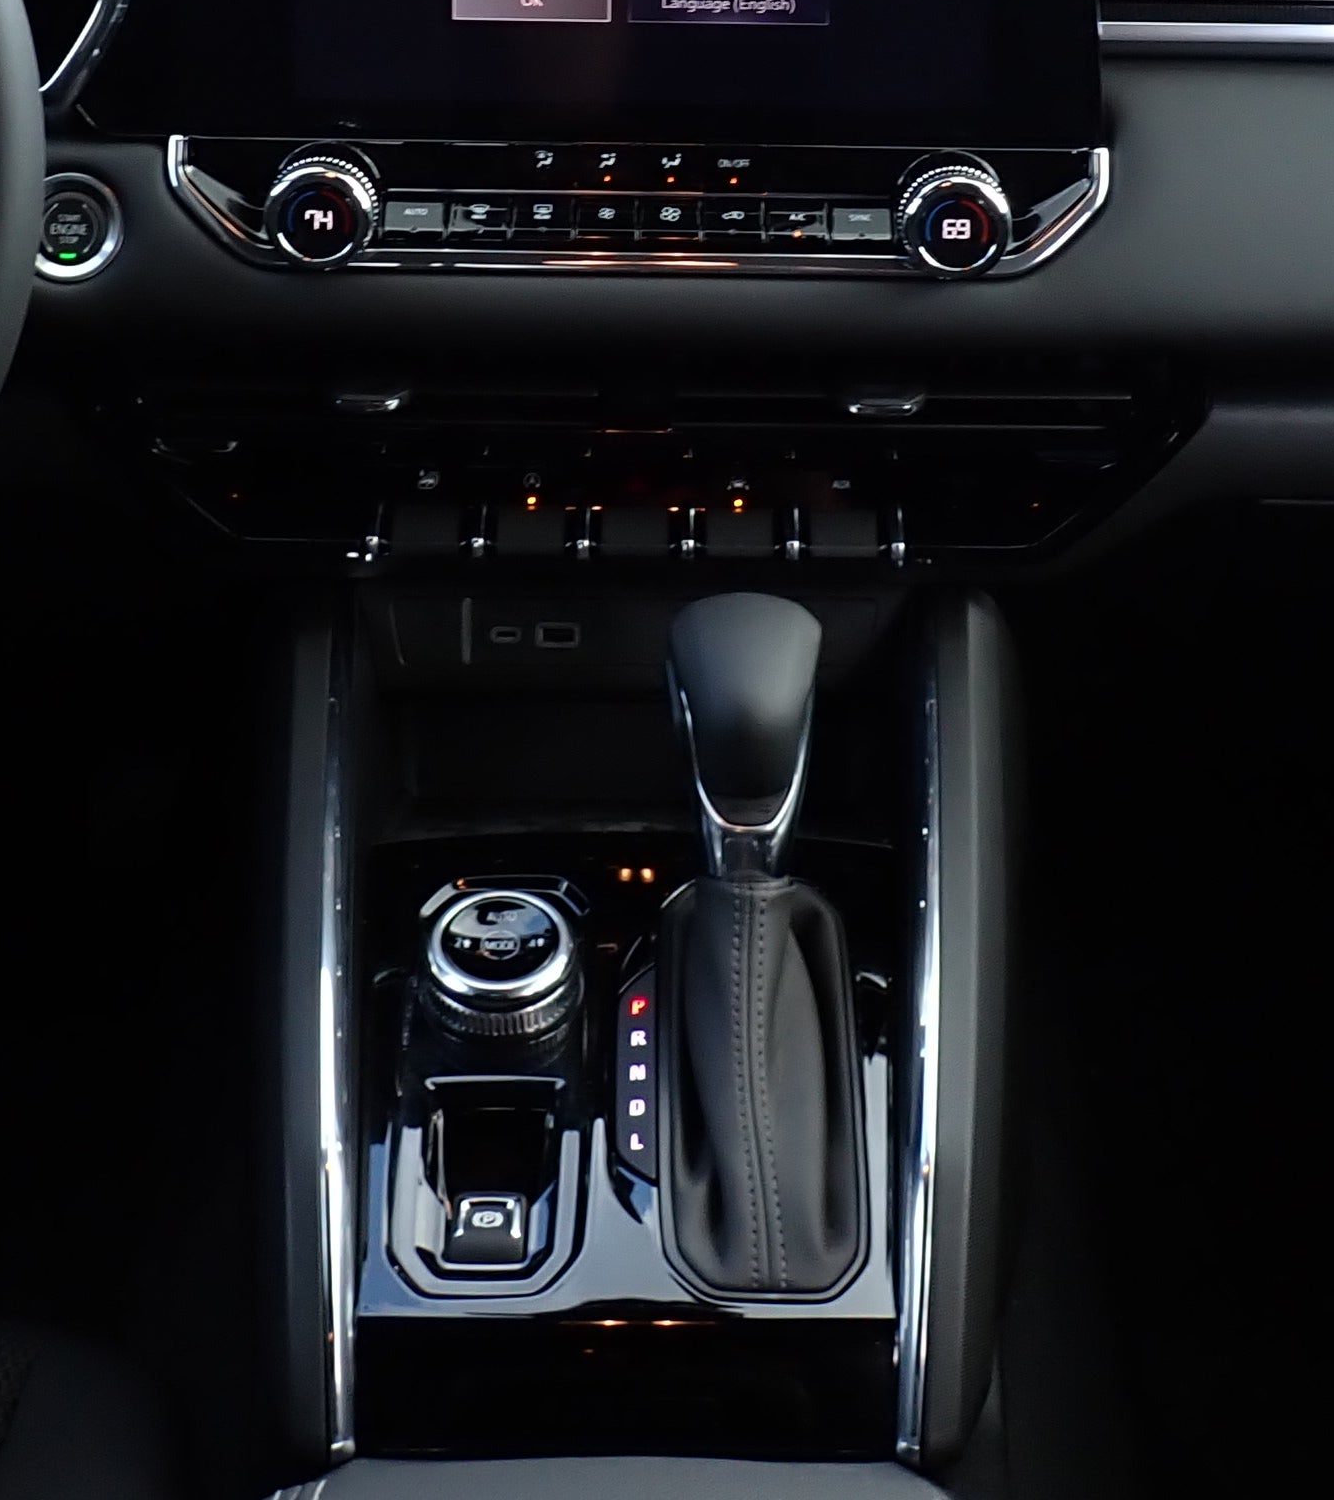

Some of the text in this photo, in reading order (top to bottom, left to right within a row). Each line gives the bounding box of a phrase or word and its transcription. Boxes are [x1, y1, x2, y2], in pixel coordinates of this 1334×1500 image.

[49, 222, 89, 236] ENGINE
[941, 218, 971, 240] 69
[630, 999, 647, 1015] P
[630, 1029, 647, 1046] R
[629, 1063, 647, 1081] N
[629, 1098, 646, 1116] D
[630, 1133, 645, 1151] L
